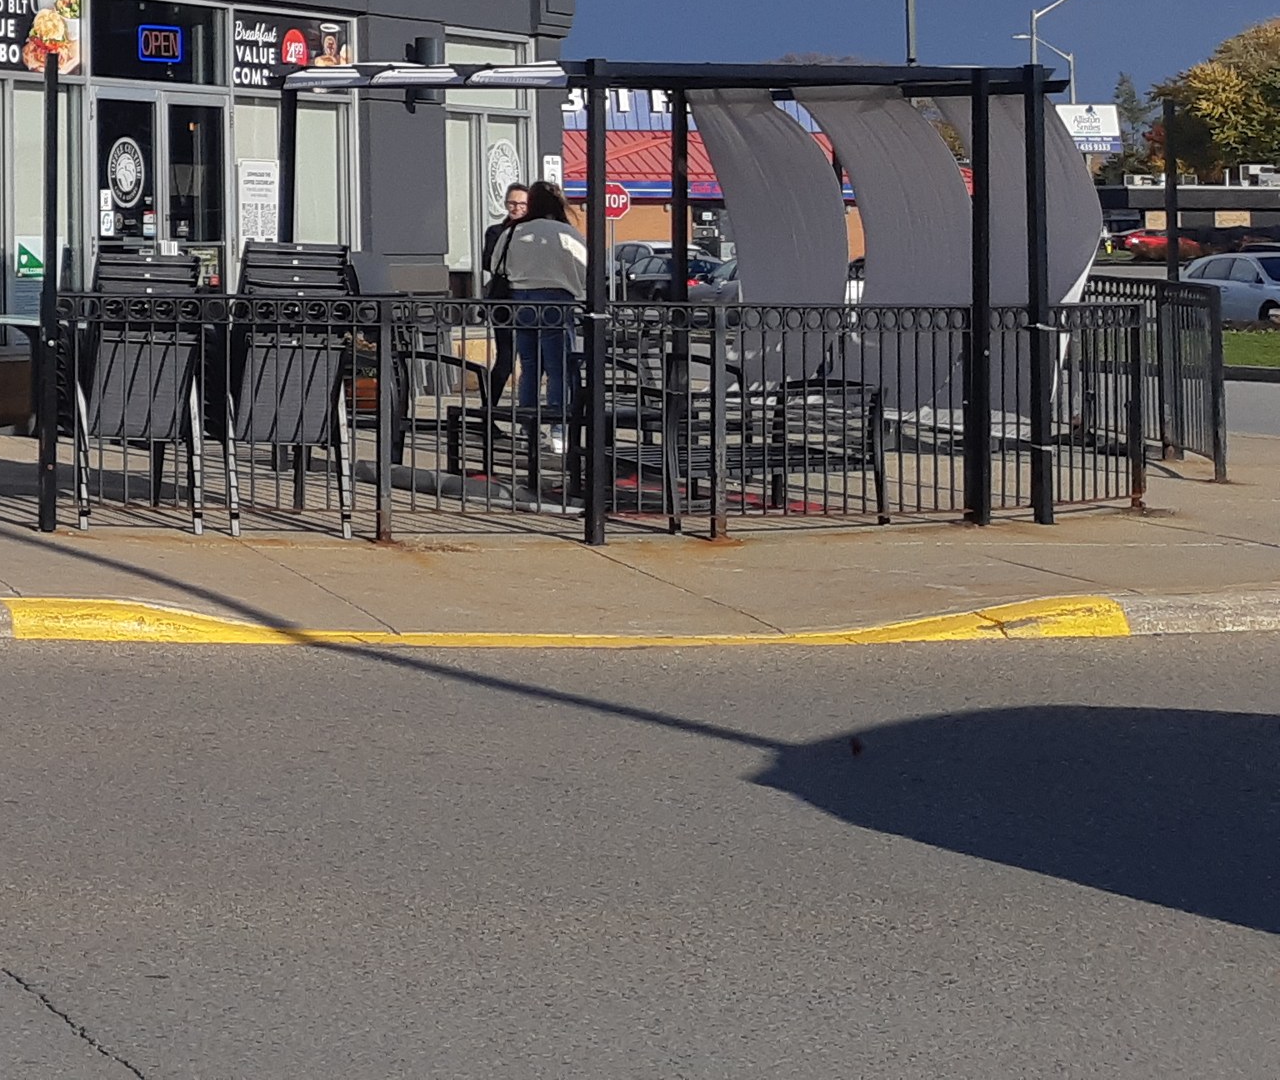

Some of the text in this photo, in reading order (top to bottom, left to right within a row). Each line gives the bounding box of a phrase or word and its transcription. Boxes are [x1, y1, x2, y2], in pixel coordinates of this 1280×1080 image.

[235, 20, 277, 46] Breakfast
[141, 31, 179, 56] OPEN
[236, 45, 275, 64] VALUE
[233, 67, 279, 85] COMB
[606, 195, 628, 208] TOP
